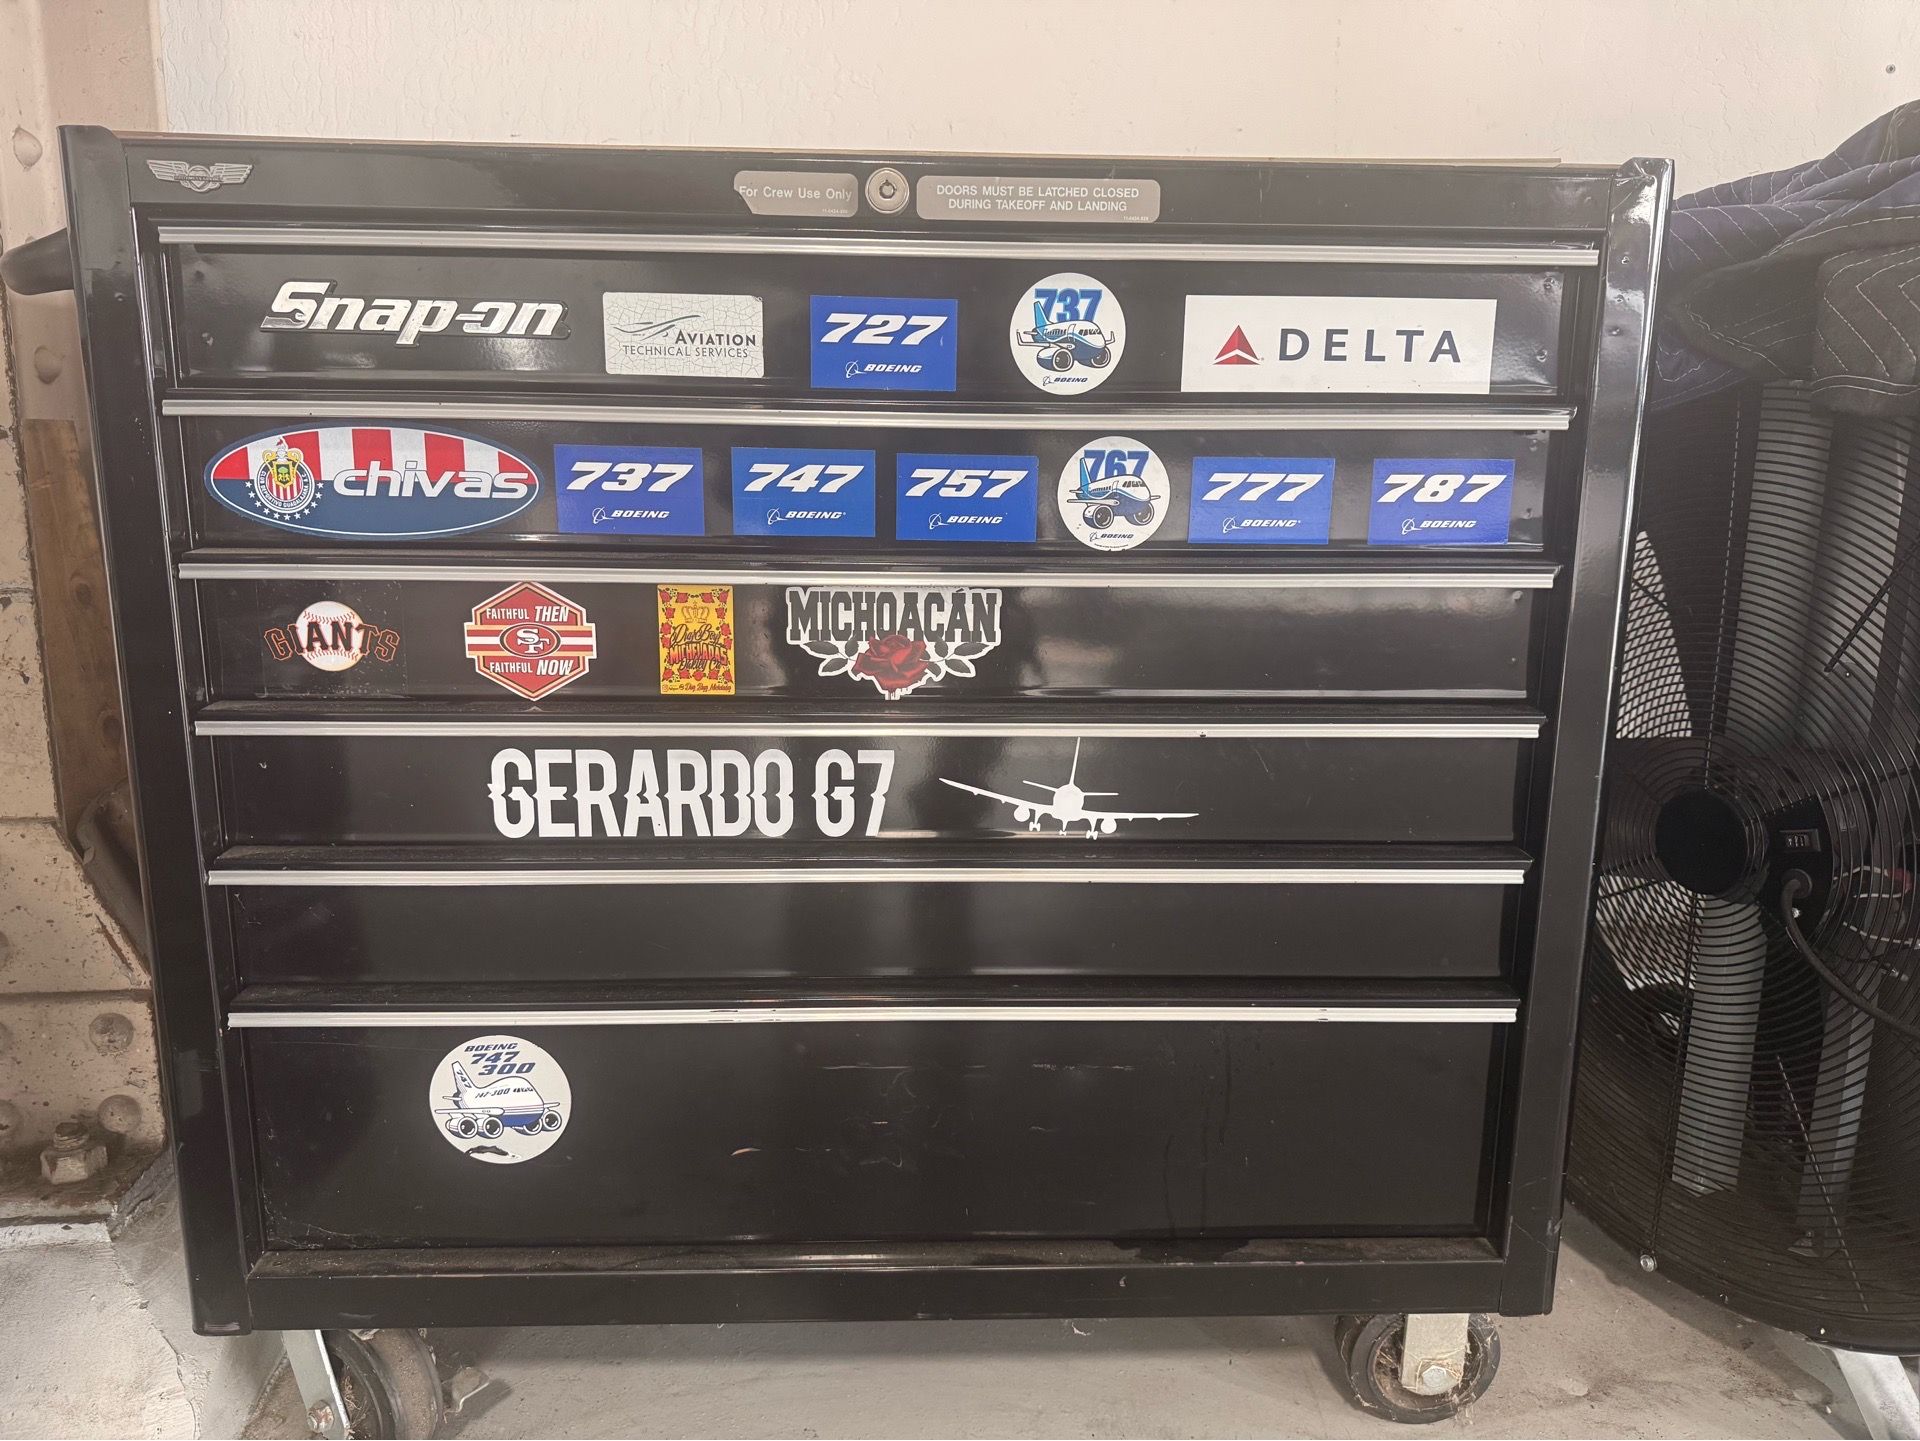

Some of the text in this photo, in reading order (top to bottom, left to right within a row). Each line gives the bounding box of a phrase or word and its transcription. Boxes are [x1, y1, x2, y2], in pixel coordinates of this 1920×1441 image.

[739, 185, 852, 201] For Crew Use Only
[936, 184, 1139, 199] DOORS MUST BE LATCHED CLOSED
[948, 198, 1127, 212] DURING TAKEOFF AND LANDING
[260, 281, 563, 345] Snap-on
[1034, 288, 1103, 323] 737
[674, 329, 756, 346] AVIATION
[820, 312, 948, 346] 727
[622, 344, 748, 358] TECHNICAL SERVICES
[1278, 328, 1461, 363] DELTA
[864, 363, 923, 373] BOEING
[1083, 449, 1150, 480] 767
[333, 460, 529, 499] chivas
[566, 461, 694, 492] 737
[743, 463, 865, 493] 747
[905, 468, 1029, 498] 757
[1201, 472, 1325, 502] 777
[1376, 474, 1507, 503] 787
[610, 509, 670, 519] BOEING
[785, 511, 843, 520] BOEING
[947, 515, 1003, 525] BOEING
[1240, 518, 1299, 528] BOEING
[1419, 520, 1477, 529] BOEING
[485, 605, 570, 622] FAITHFUL THEN
[788, 588, 998, 643] MICHOACÁN
[263, 620, 401, 662] GIANTS
[516, 628, 550, 654] SF
[668, 642, 729, 666] MICHELADAS
[489, 659, 574, 676] FAITHFUL NOW
[487, 748, 895, 838] GERARDO G7
[464, 1042, 518, 1052] BOEING
[471, 1051, 520, 1065] 747
[456, 1069, 472, 1088] 747
[478, 1063, 536, 1076] 300
